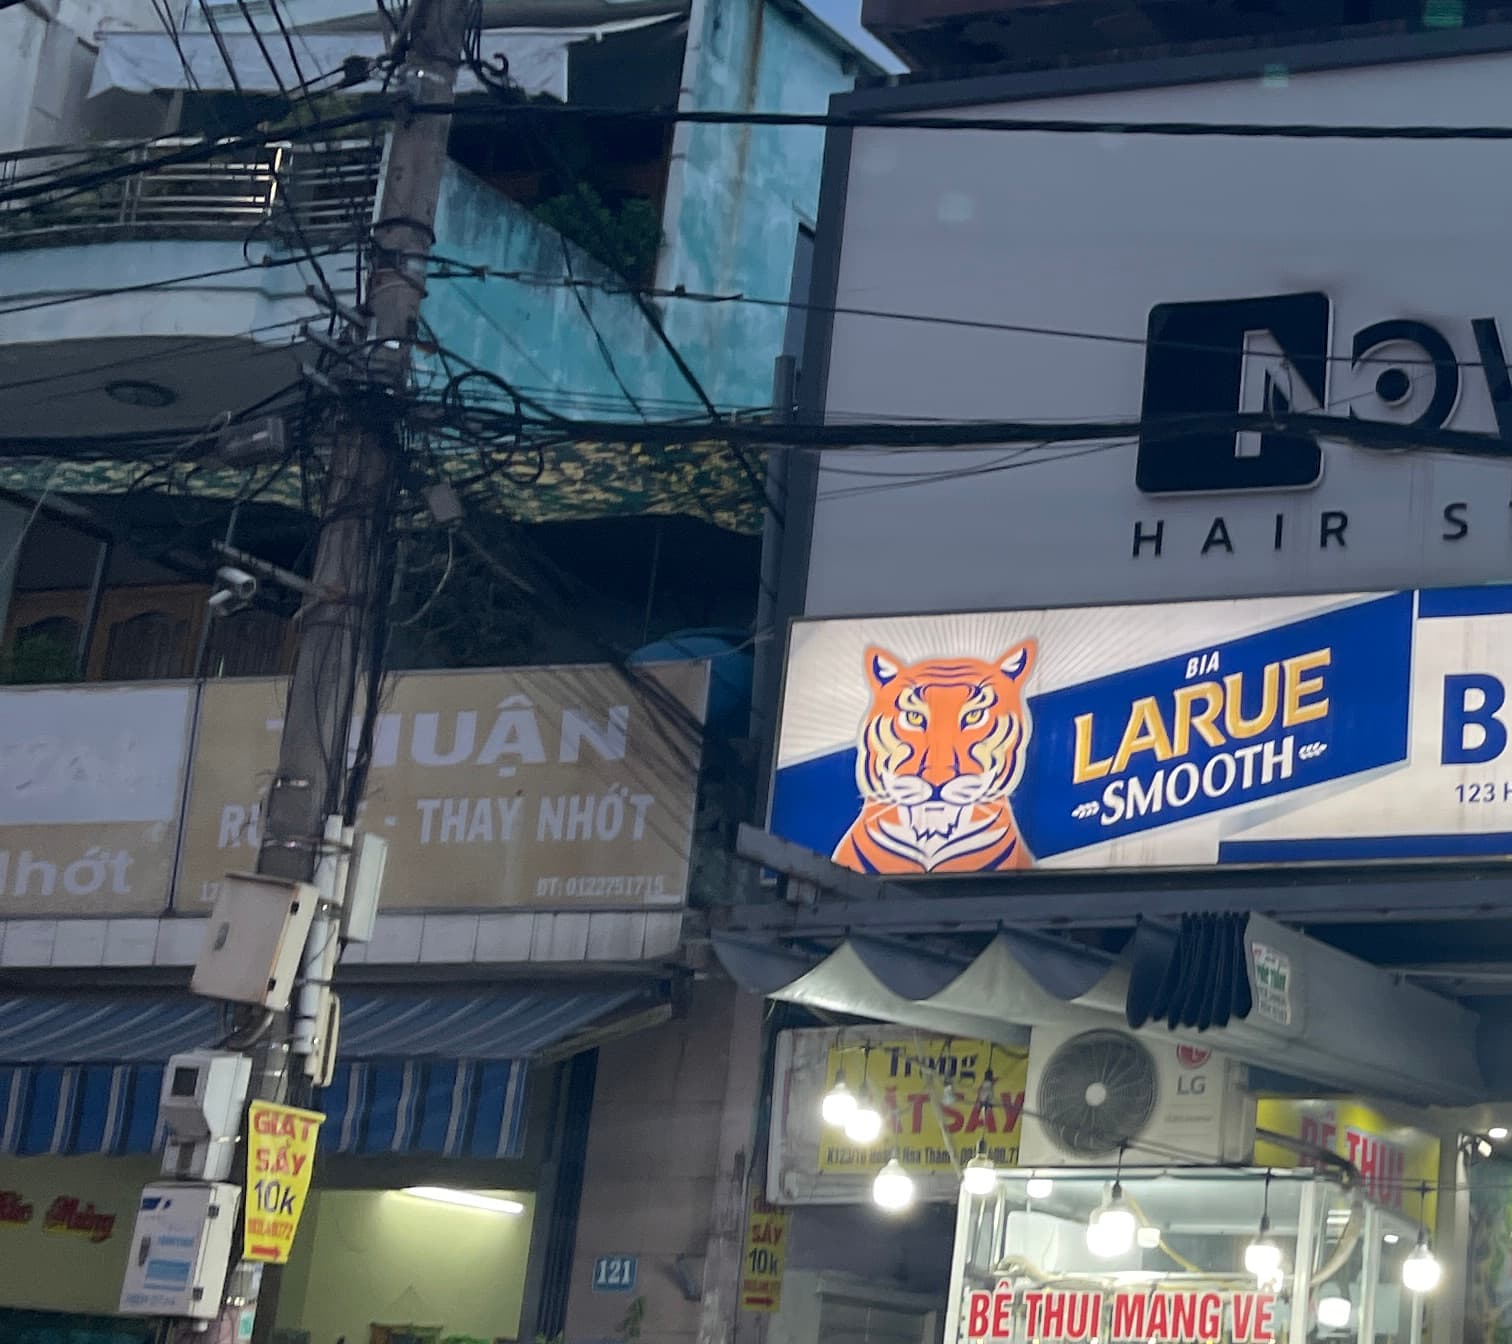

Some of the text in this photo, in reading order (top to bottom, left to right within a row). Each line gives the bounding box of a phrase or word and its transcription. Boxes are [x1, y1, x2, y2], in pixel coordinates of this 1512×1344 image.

[1131, 511, 1348, 556] HAIR
[1185, 651, 1220, 680] BIA
[1073, 647, 1332, 785] LARUE
[1100, 735, 1295, 826] SMOOTH
[1455, 783, 1496, 804] 123
[416, 797, 530, 844] THAY
[536, 782, 655, 843] NHỚT
[1176, 1075, 1207, 1096] LG
[254, 1179, 297, 1216] 10k
[598, 1259, 632, 1286] 121
[967, 1279, 1013, 1339] BÊ
[1025, 1292, 1102, 1339] THUI
[1112, 1292, 1221, 1340] MANG
